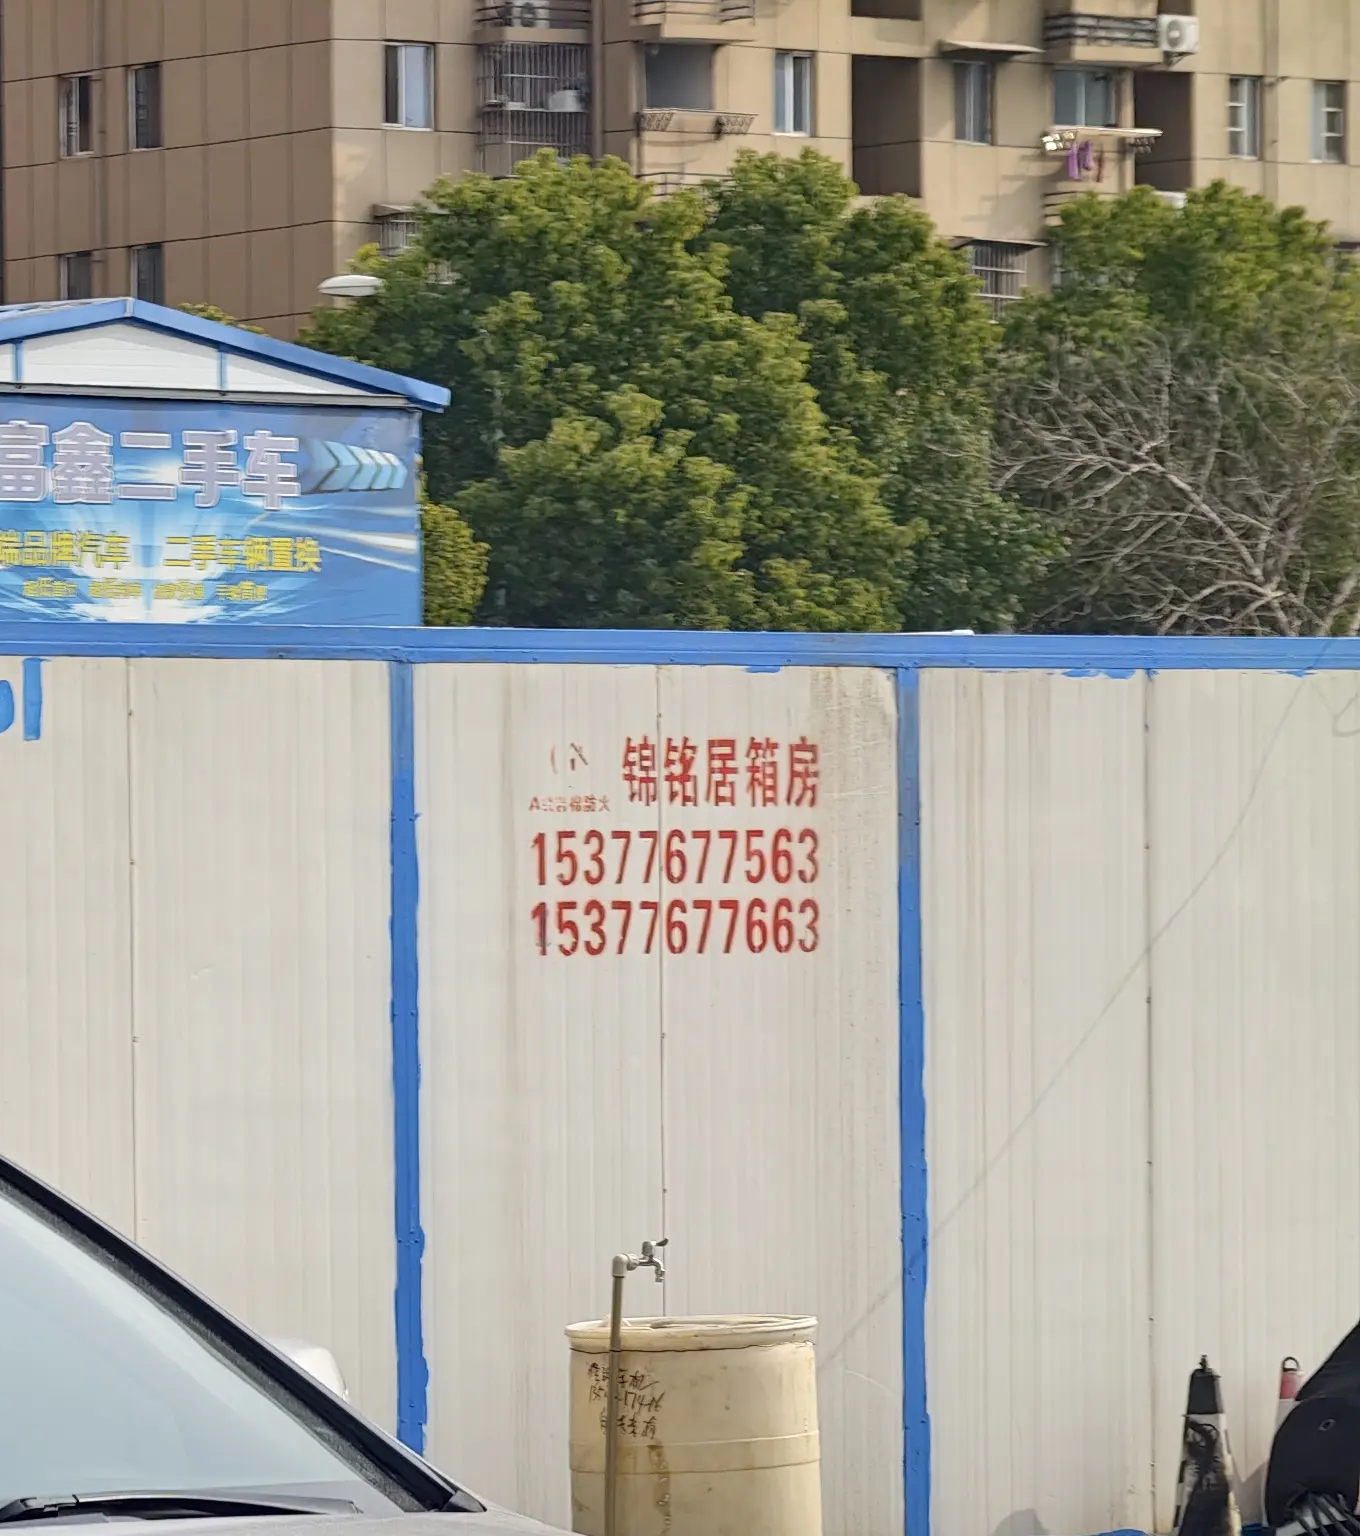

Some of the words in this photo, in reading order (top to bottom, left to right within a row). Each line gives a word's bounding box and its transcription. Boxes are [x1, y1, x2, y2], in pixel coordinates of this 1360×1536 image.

[622, 736, 820, 808] 锦铭居箱房
[531, 829, 820, 886] 15377677563
[531, 898, 820, 957] 15377677663
